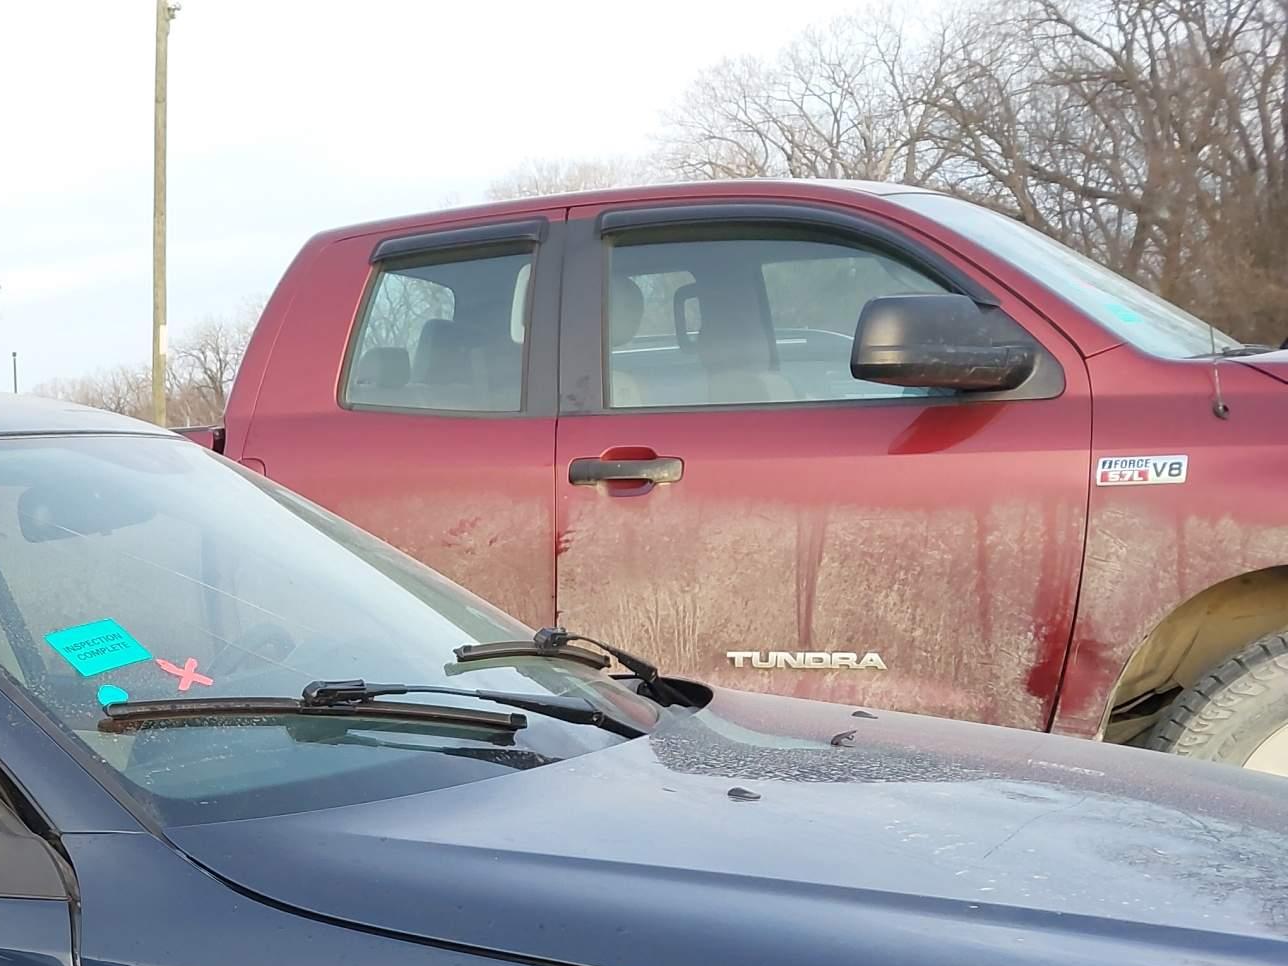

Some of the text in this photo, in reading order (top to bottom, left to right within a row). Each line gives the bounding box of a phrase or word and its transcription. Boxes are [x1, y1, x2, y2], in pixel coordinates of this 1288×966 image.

[1153, 462, 1183, 477] V8
[63, 632, 123, 653] INSPECTION
[77, 642, 130, 660] COMPLETE
[726, 650, 888, 670] TUNDRA
